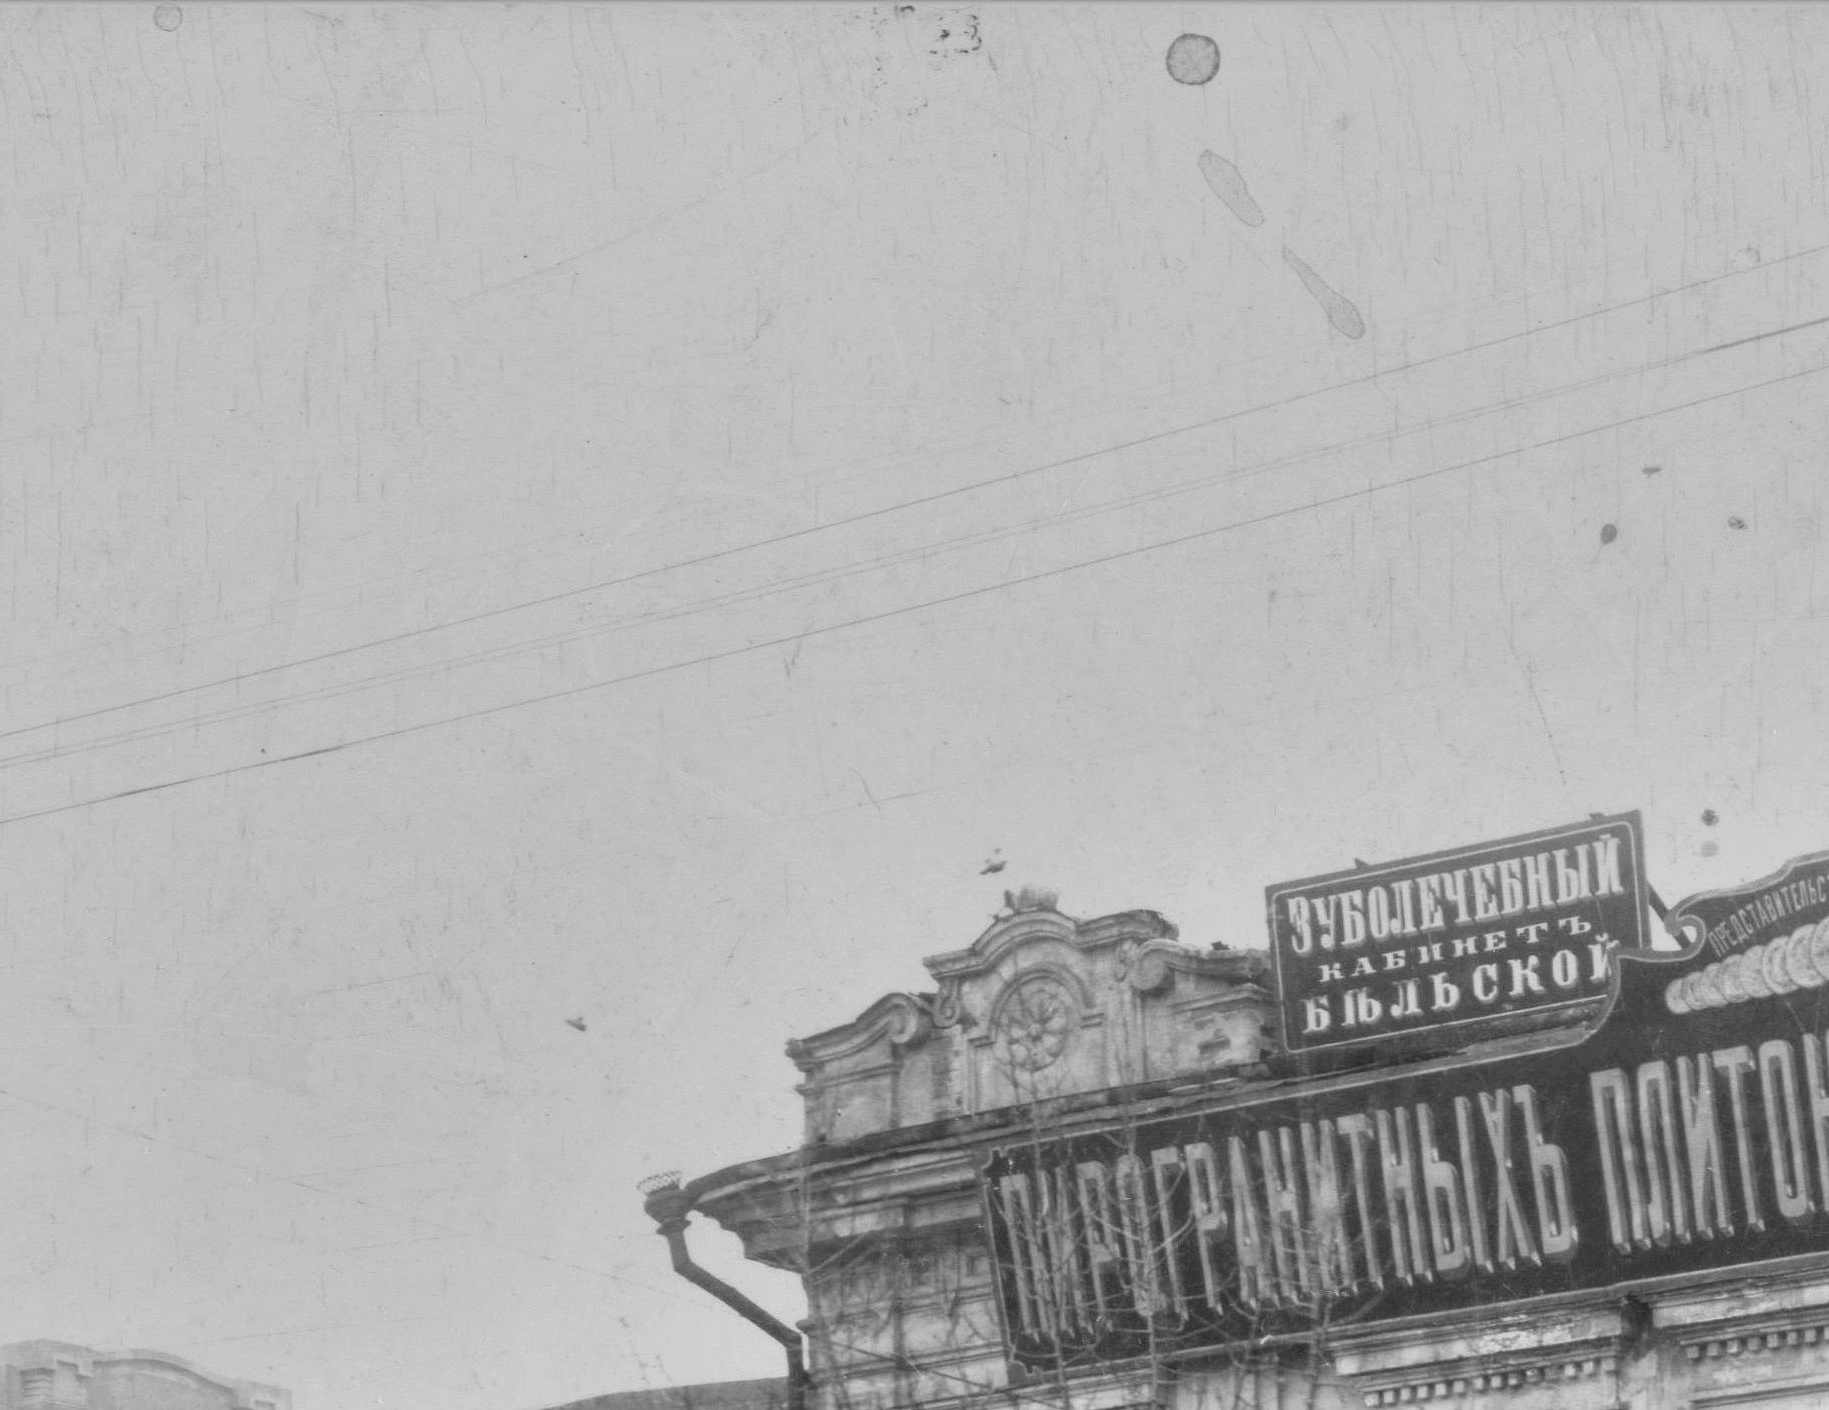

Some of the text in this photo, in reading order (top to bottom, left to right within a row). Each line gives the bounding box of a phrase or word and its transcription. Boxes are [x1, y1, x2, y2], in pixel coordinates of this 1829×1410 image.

[1289, 834, 1625, 955] ЗУБОЛЕЧЕБНЫЙ
[1318, 914, 1594, 984] КАБИНЕТЪ
[1304, 938, 1621, 1035] БѢЛЬСКОЙ
[999, 1083, 1578, 1345] ПИРОГРАНИТНЫХЪ
